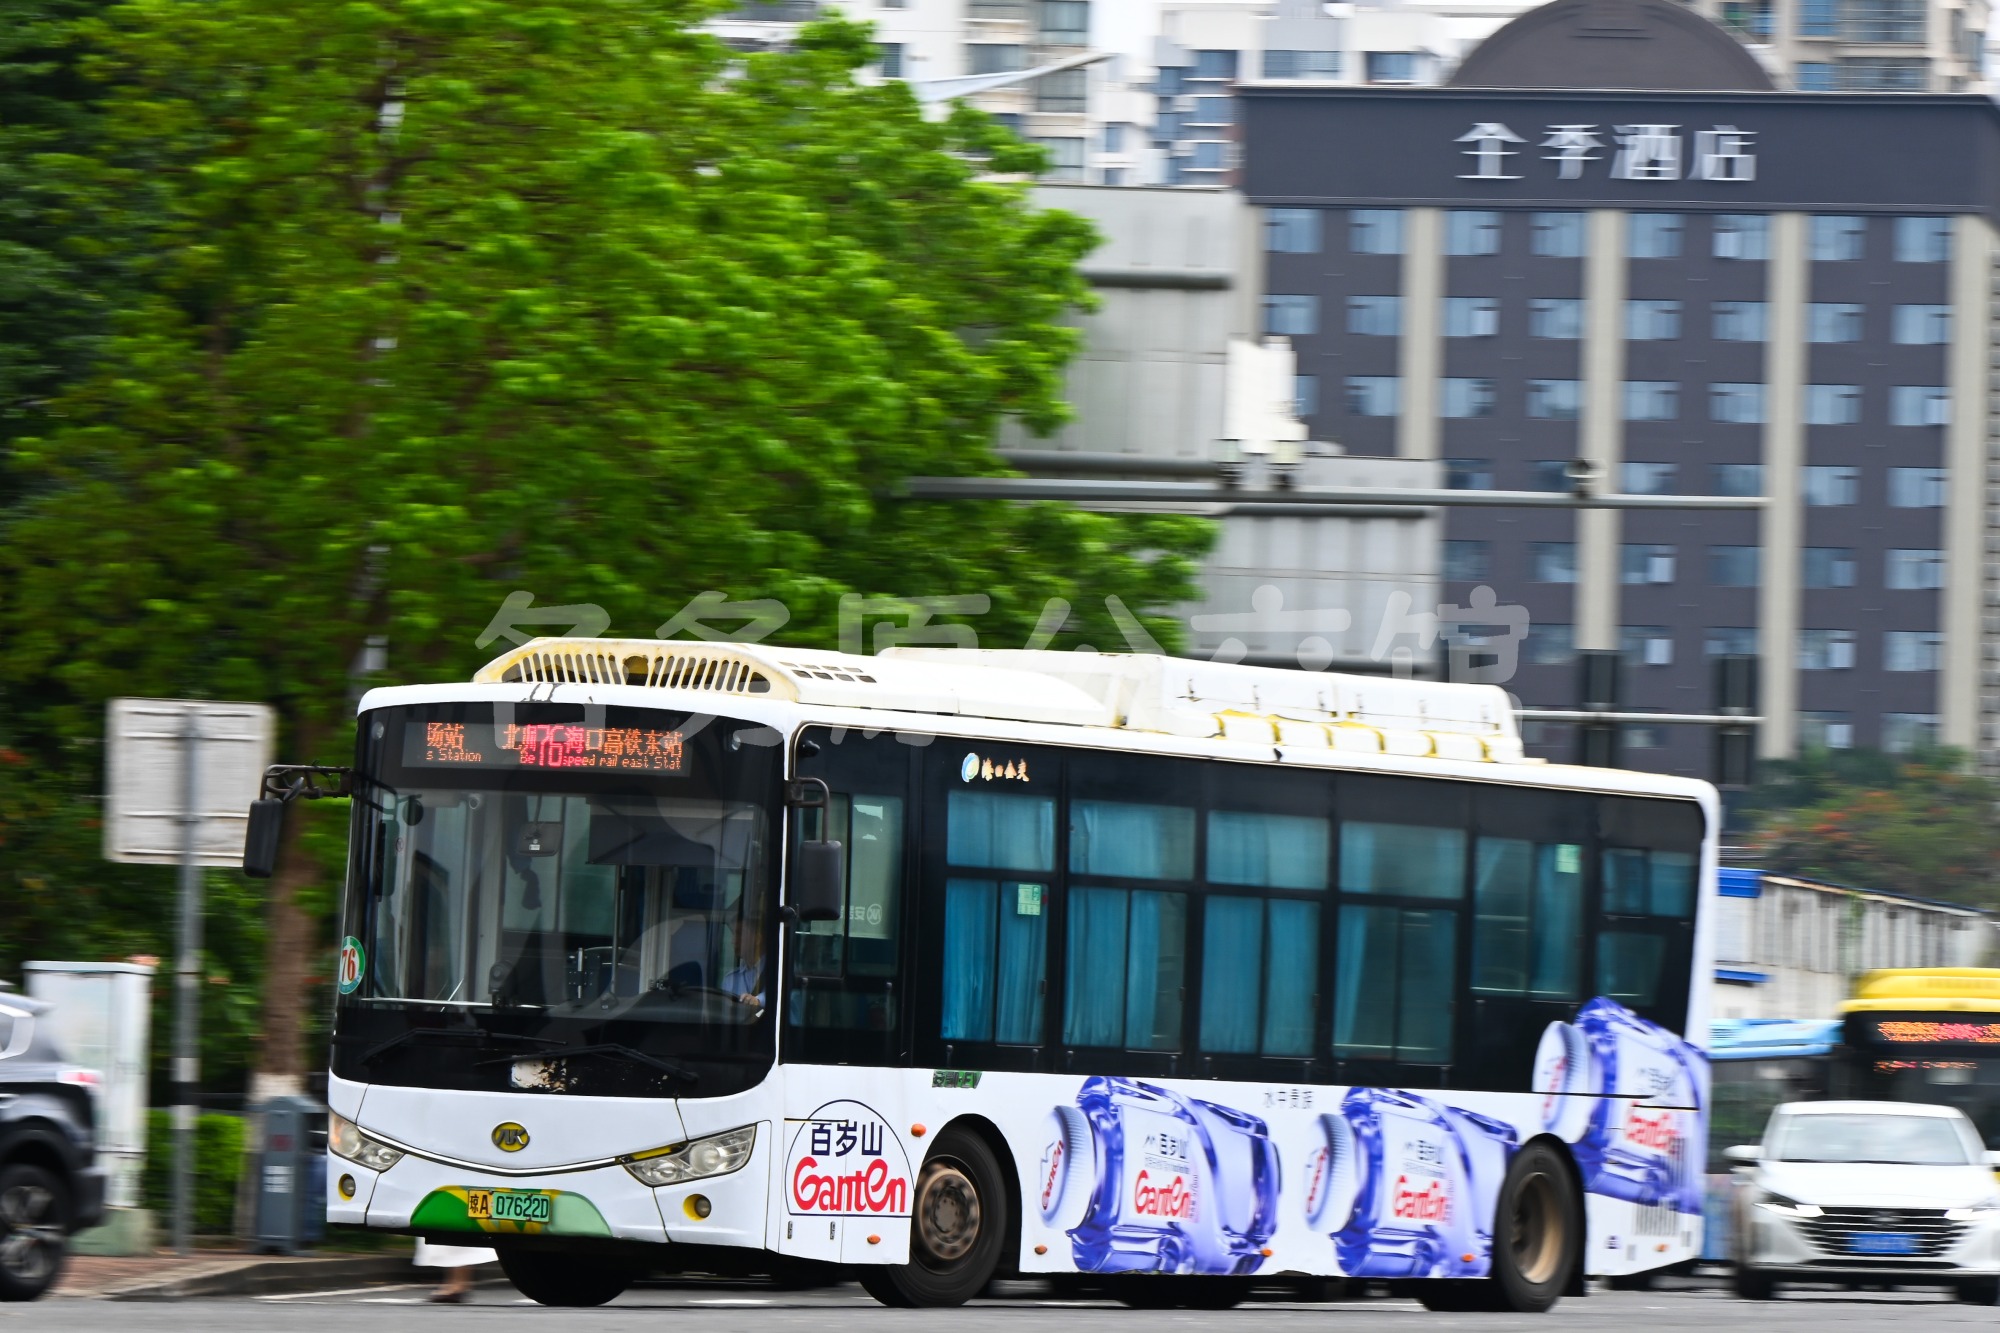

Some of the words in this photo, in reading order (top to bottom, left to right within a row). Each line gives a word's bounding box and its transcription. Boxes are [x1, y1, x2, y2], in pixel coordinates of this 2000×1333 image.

[1453, 122, 1760, 182] 全季酒店
[439, 748, 481, 762] Station
[342, 947, 356, 982] 76
[811, 1121, 883, 1158] 百岁山
